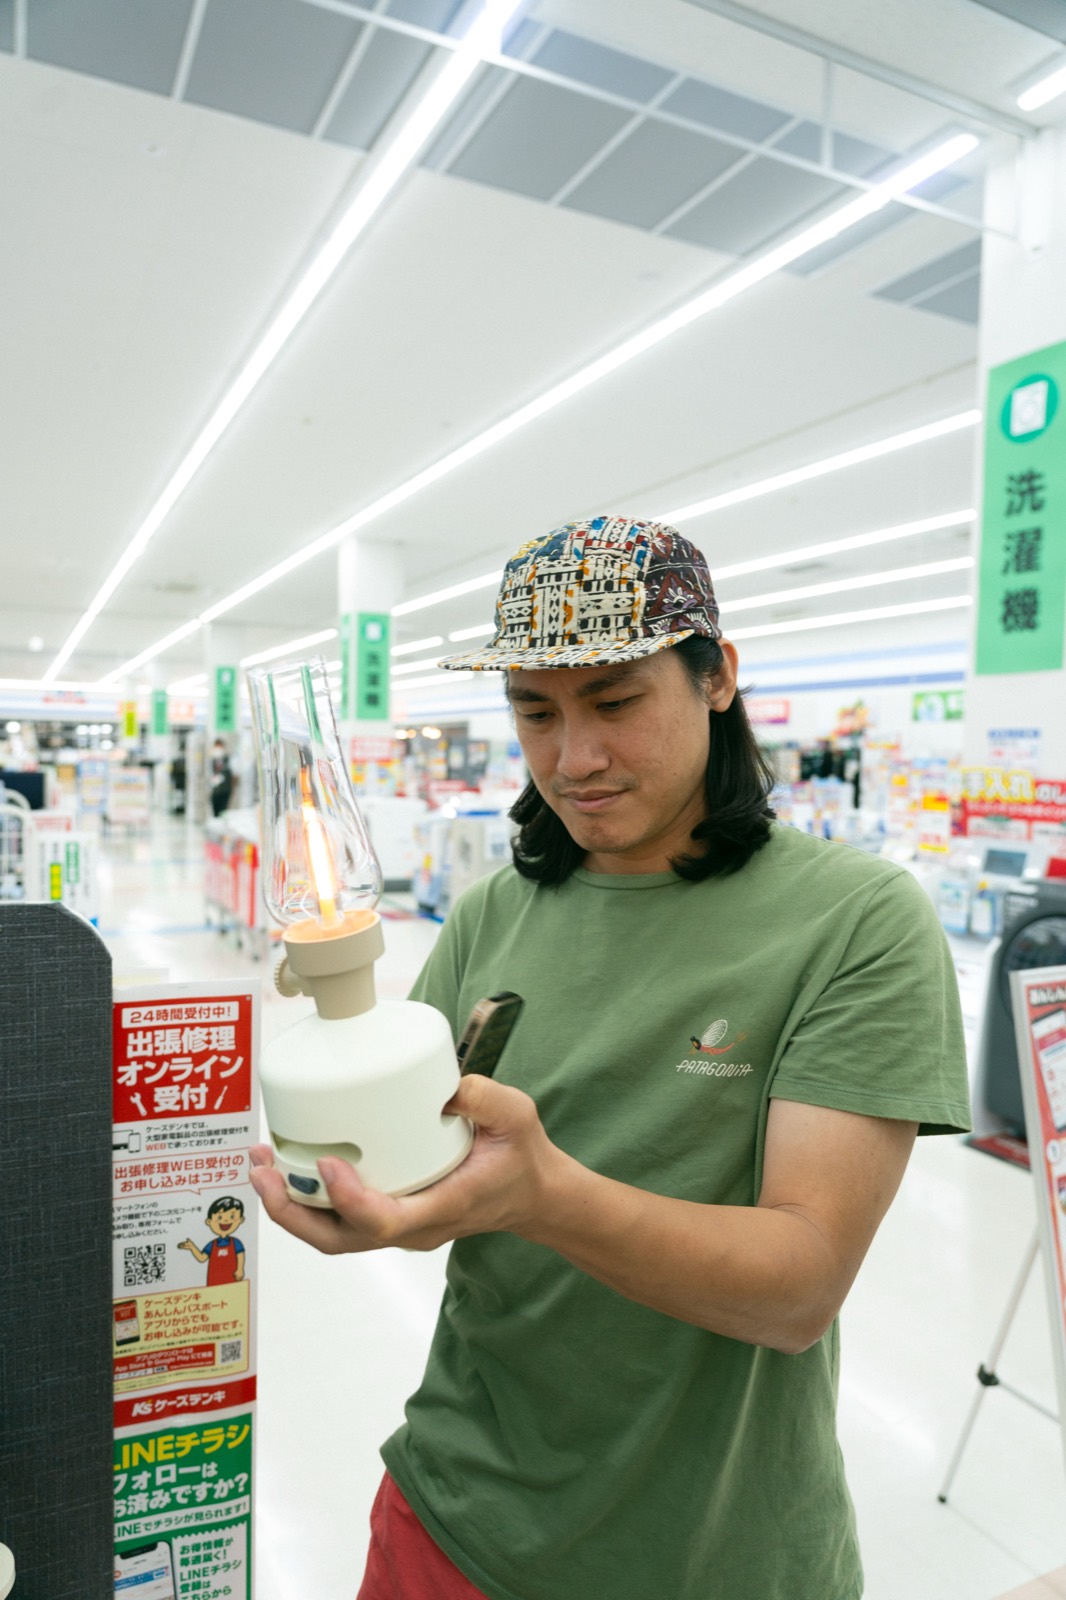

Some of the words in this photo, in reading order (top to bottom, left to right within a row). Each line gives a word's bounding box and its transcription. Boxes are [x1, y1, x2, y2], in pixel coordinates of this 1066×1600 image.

[1000, 468, 1045, 634] 洗濯機
[130, 1006, 231, 1024] 24時間受付中!
[127, 1025, 236, 1058] 出張修理
[117, 1055, 244, 1086] オンライン
[154, 1083, 209, 1113] 受付
[115, 1155, 244, 1179] 出張修理WEB受付の
[120, 1169, 239, 1193] お申し込みはコチラ
[144, 1293, 202, 1308] ケーズデンキ
[144, 1301, 228, 1319] あんしんパスポート
[144, 1314, 209, 1330] アプリからでも
[155, 1390, 226, 1412] ケーズデンキ
[114, 1461, 218, 1495] フォローは
[114, 1502, 247, 1538] INEでチラシが見られます!
[180, 1559, 242, 1582] LINEチラシ
